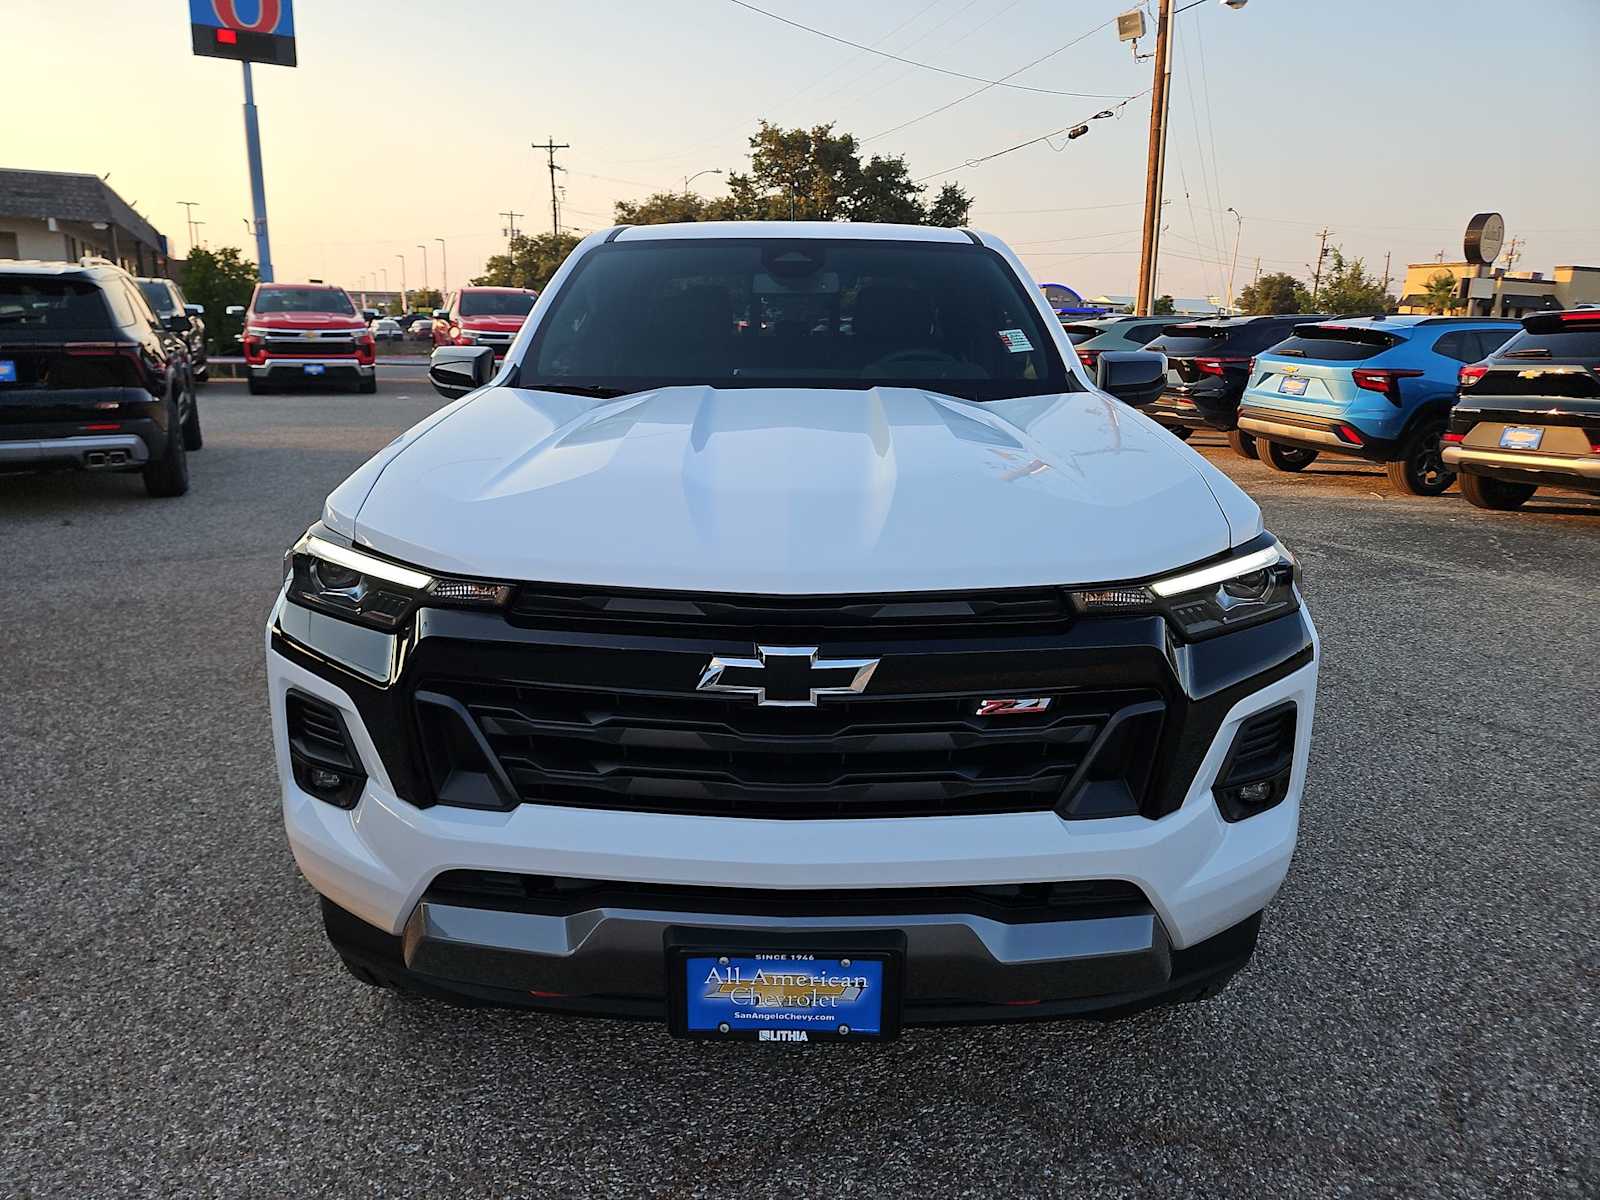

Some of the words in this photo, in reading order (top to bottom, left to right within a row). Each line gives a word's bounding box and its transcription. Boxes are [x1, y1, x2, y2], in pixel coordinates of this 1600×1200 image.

[754, 953, 788, 961] SINCE
[790, 953, 815, 961] 1946
[703, 966, 741, 985] All
[750, 968, 868, 988] American
[730, 986, 838, 1008] Chevrolet
[734, 1011, 835, 1022] SanAngeloChevy.com
[770, 1030, 808, 1042] LITHIA
